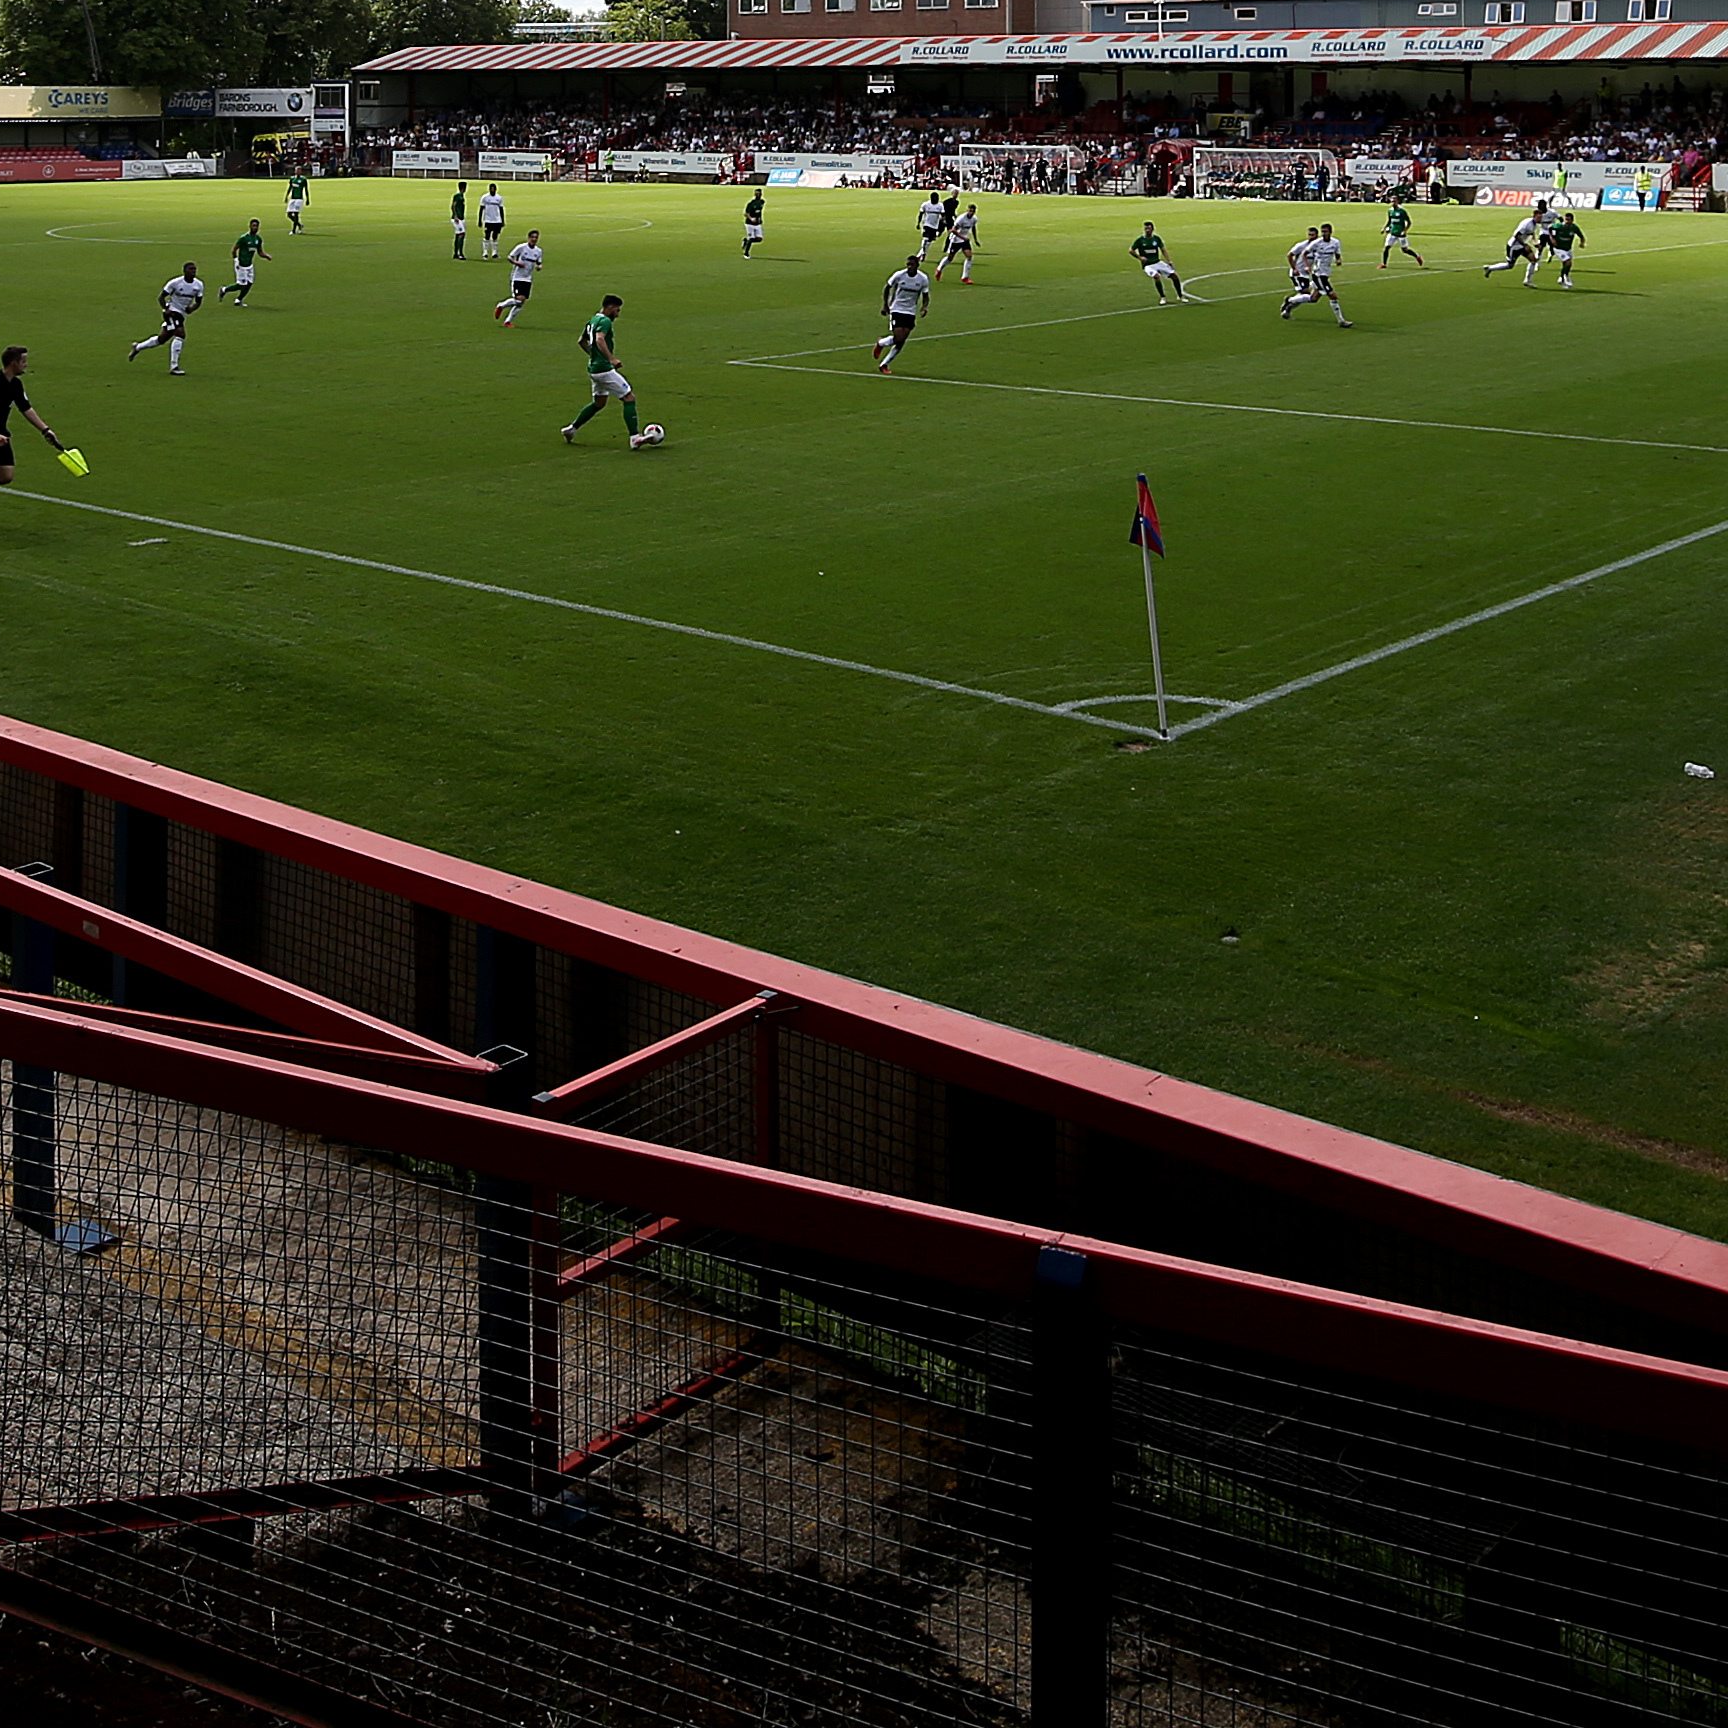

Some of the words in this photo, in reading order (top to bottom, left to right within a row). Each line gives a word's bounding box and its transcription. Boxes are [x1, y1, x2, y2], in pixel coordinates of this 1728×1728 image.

[1006, 44, 1068, 54] R.COLLARD
[1311, 41, 1386, 52] R.COLLARD
[1404, 39, 1483, 50] R.COLLARD
[911, 46, 970, 55] R.COLLARD
[1106, 44, 1288, 59] www.rcollard.com
[54, 92, 109, 104] CAREYS
[167, 95, 213, 111] Bridges
[219, 93, 251, 102] BARONS
[1218, 115, 1245, 129] EBB
[1355, 163, 1404, 171] R.COLLARD
[1453, 164, 1505, 172] R.COLLARD
[1526, 169, 1552, 180] Skip
[1623, 190, 1653, 201] JAO
